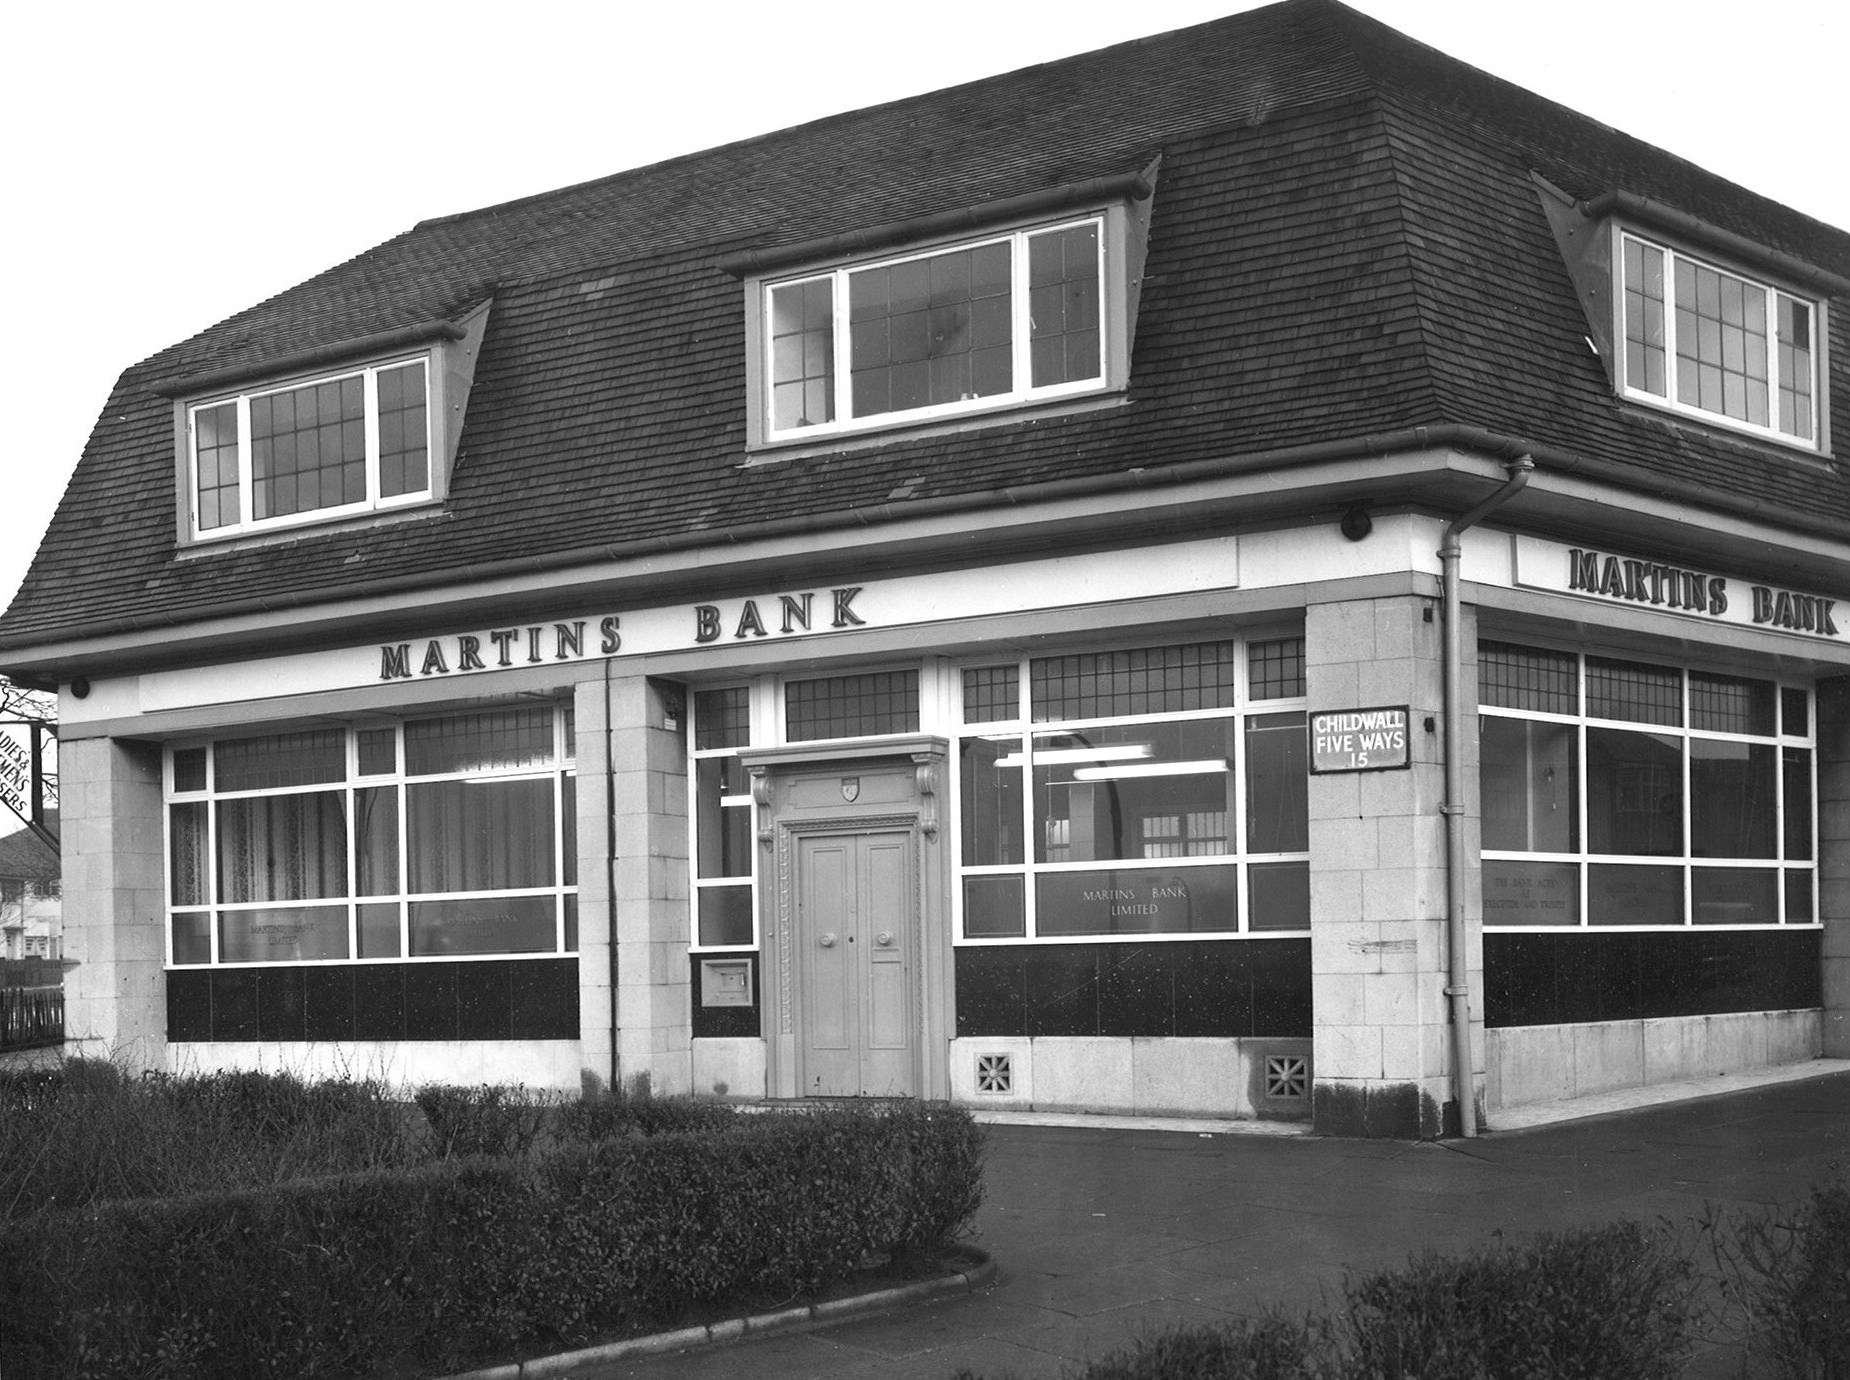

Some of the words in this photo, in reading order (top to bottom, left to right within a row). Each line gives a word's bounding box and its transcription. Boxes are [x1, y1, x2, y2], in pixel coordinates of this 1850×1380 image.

[1569, 548, 1728, 616] MARTINS
[1752, 585, 1839, 636] BANK
[379, 616, 621, 680] MARTINS
[694, 586, 867, 644] BANK
[1315, 711, 1404, 734] CHILDWALL
[1316, 735, 1353, 754] FIVE
[1359, 731, 1405, 751] WAYS
[1351, 752, 1369, 768] 15
[1083, 889, 1136, 901] MARTINS
[1152, 886, 1187, 899] BANK
[1111, 903, 1159, 916] LIMITED
